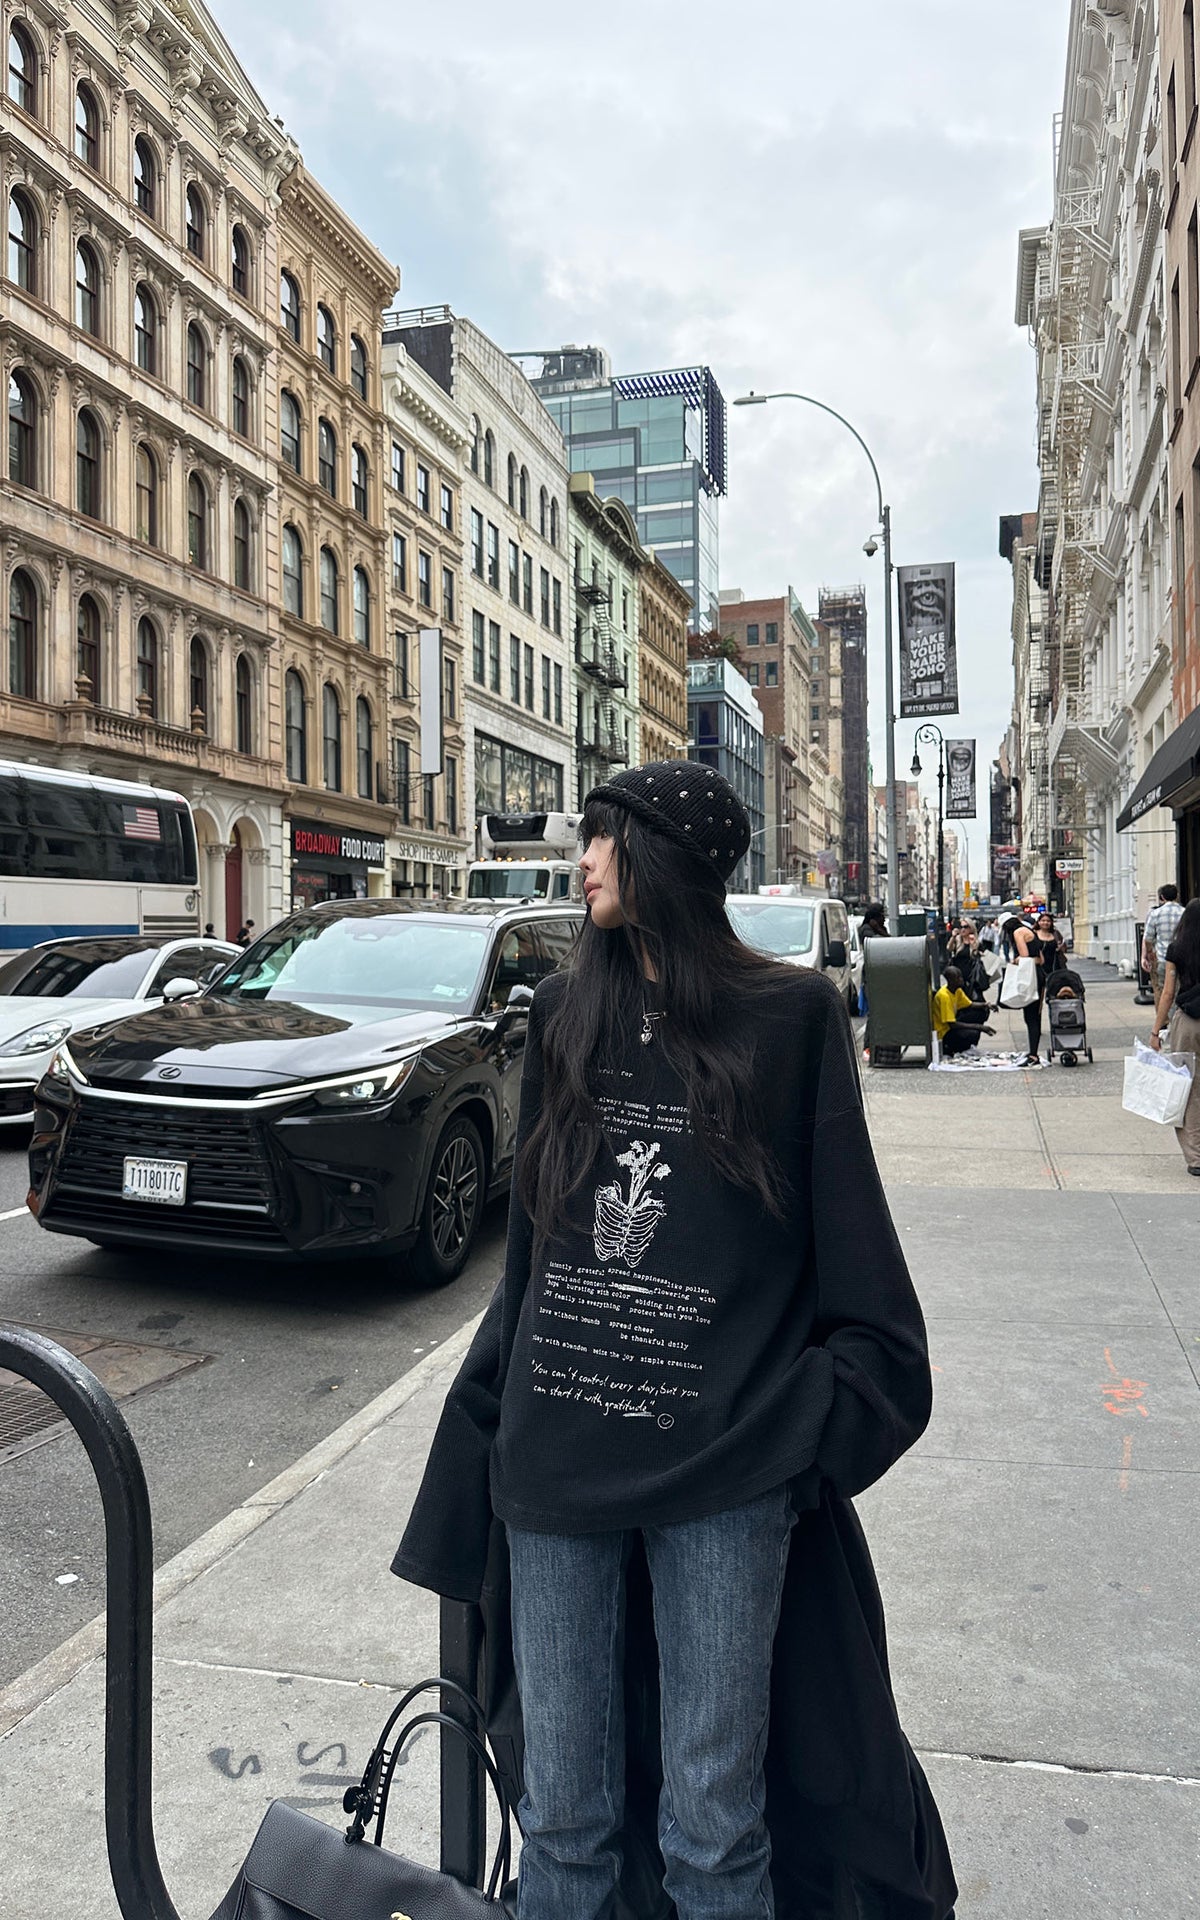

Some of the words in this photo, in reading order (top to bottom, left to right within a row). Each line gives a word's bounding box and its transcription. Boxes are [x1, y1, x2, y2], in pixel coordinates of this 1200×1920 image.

[910, 632, 945, 649] MAKE
[910, 643, 945, 659] YOUR
[909, 652, 946, 669] MARK
[910, 662, 946, 679] SOHO
[295, 830, 340, 856] BROADWAY
[341, 837, 362, 858] FOOD
[362, 841, 385, 862] COURT
[399, 841, 419, 858] SHOP
[421, 845, 435, 861] THE
[436, 848, 459, 864] SAMPLE
[620, 1070, 633, 1078] for
[653, 1124, 683, 1133] everyday
[131, 1167, 182, 1192] T118017C
[569, 1276, 581, 1284] and
[583, 1280, 606, 1289] content
[653, 1287, 690, 1301] flowering
[699, 1296, 717, 1304] with
[577, 1267, 605, 1276] grateful
[607, 1267, 631, 1277] spread
[632, 1271, 668, 1285] happiness
[685, 1285, 710, 1295] pollen
[554, 1292, 576, 1303] family
[586, 1300, 621, 1312] everything
[629, 1307, 656, 1317] protect
[660, 1311, 677, 1319] what
[695, 1315, 711, 1325] love
[566, 1283, 595, 1295] bursting
[597, 1288, 610, 1297] with
[611, 1291, 631, 1300] color
[635, 1298, 663, 1310] abiding
[665, 1303, 674, 1311] in
[677, 1305, 698, 1314] faith
[539, 1306, 552, 1315] love
[553, 1310, 579, 1321] without
[609, 1321, 632, 1329] spread
[633, 1324, 655, 1334] cheer
[545, 1338, 560, 1347] with
[609, 1351, 620, 1359] the
[622, 1353, 635, 1362] joy
[640, 1356, 665, 1365] simple
[620, 1332, 628, 1340] be
[631, 1334, 665, 1347] thankful
[667, 1340, 689, 1351] daily
[551, 1366, 579, 1381] can't
[579, 1373, 610, 1387] control
[610, 1381, 634, 1393] every
[660, 1382, 678, 1396] but
[680, 1388, 699, 1398] you
[533, 1385, 547, 1394] can
[550, 1385, 574, 1399] start
[574, 1388, 583, 1401] it
[584, 1392, 603, 1407] with
